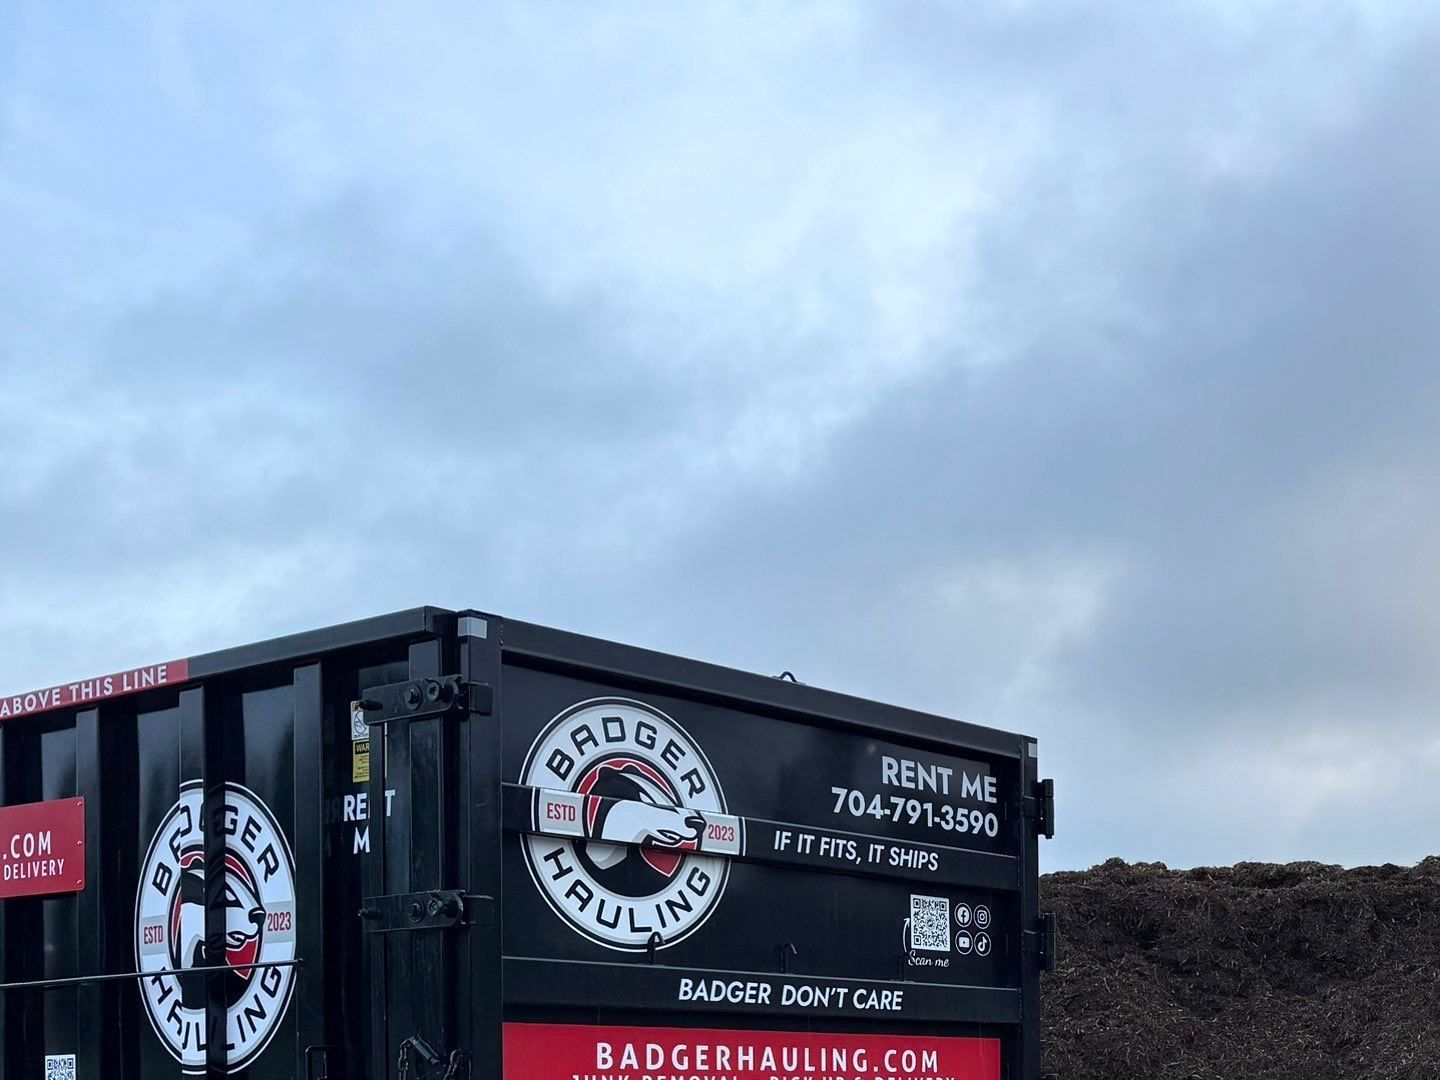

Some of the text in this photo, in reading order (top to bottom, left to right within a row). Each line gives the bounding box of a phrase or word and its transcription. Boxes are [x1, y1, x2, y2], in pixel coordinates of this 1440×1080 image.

[0, 665, 167, 716] ABOVE THIS LINE
[546, 717, 706, 799] BADGER
[881, 756, 998, 803] RENT ME
[343, 789, 396, 822] RET
[547, 802, 576, 822] ESTD
[831, 787, 999, 838] 704-791-3590
[708, 824, 735, 842] 2023
[774, 830, 939, 871] IF IT FITS, IT SHIPS
[4, 858, 64, 880] DELIVERY
[543, 847, 711, 933] HAULING
[144, 924, 163, 945] ESTD
[267, 911, 292, 931] 2023
[908, 950, 950, 967] Scan me
[678, 978, 903, 1011] BADGER DON'T CARE
[596, 1042, 938, 1073] BADGERHAULING.COM
